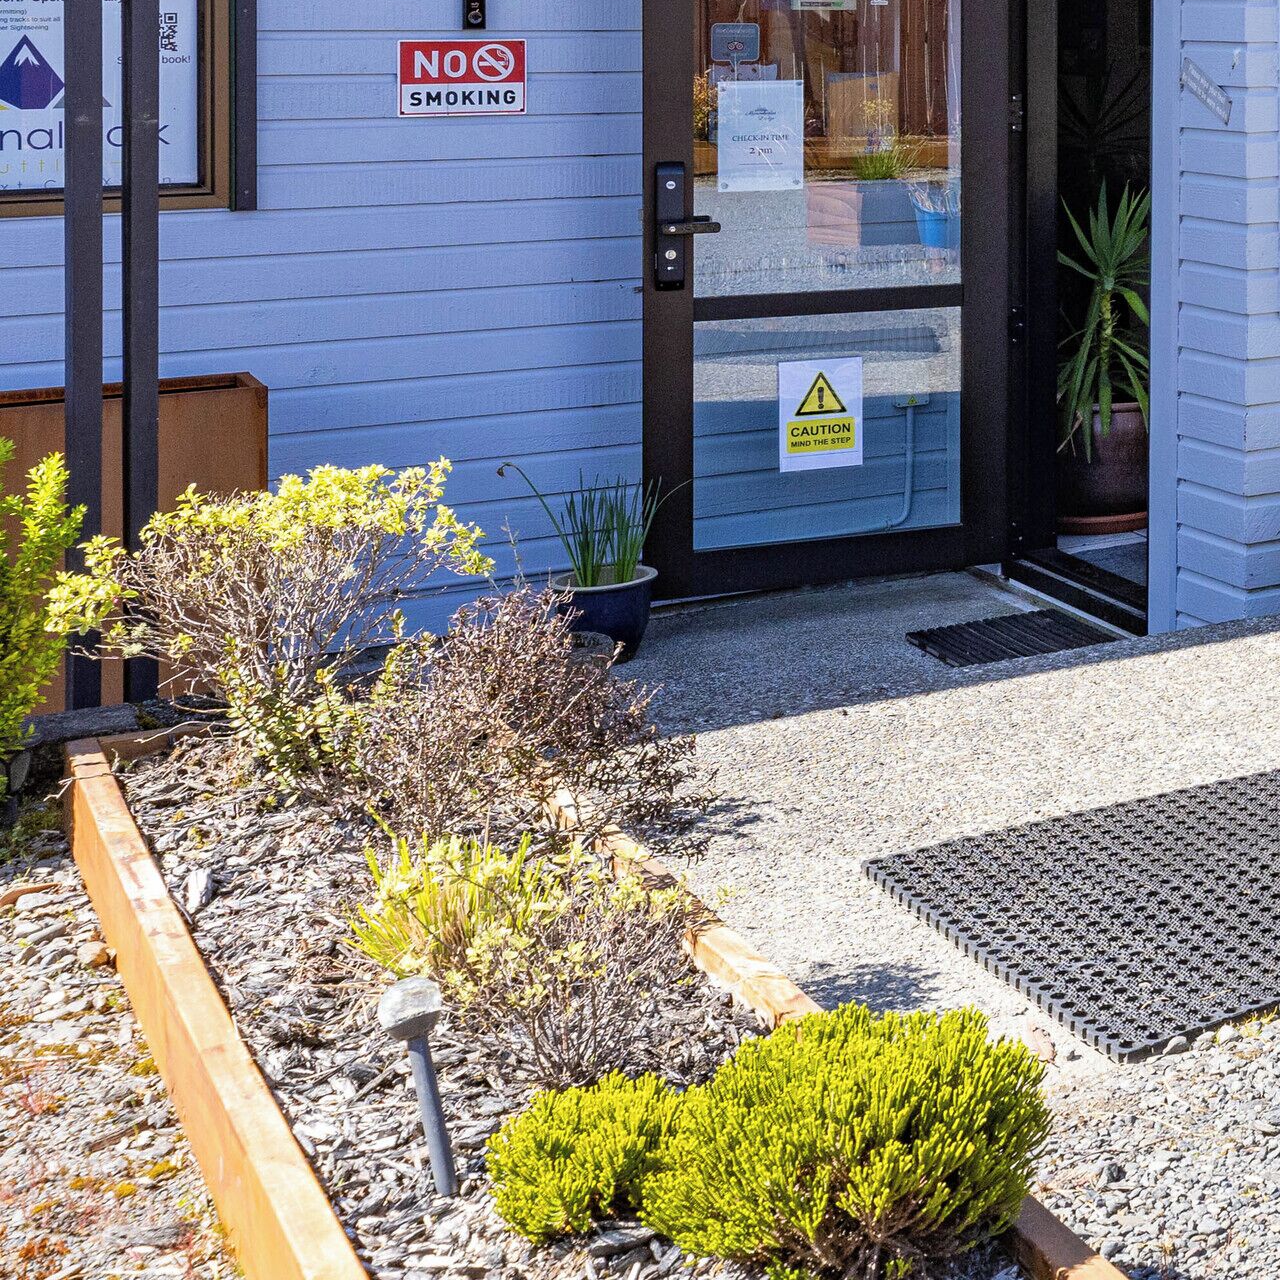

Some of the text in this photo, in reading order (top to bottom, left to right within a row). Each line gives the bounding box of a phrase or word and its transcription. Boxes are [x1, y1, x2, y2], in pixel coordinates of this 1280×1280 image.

[162, 55, 191, 64] book!
[414, 50, 467, 78] NO
[409, 90, 517, 106] SMOKING
[732, 134, 770, 142] CHECK-IN
[758, 148, 773, 156] pm
[791, 423, 851, 437] CAUTION
[791, 440, 811, 448] MIND
